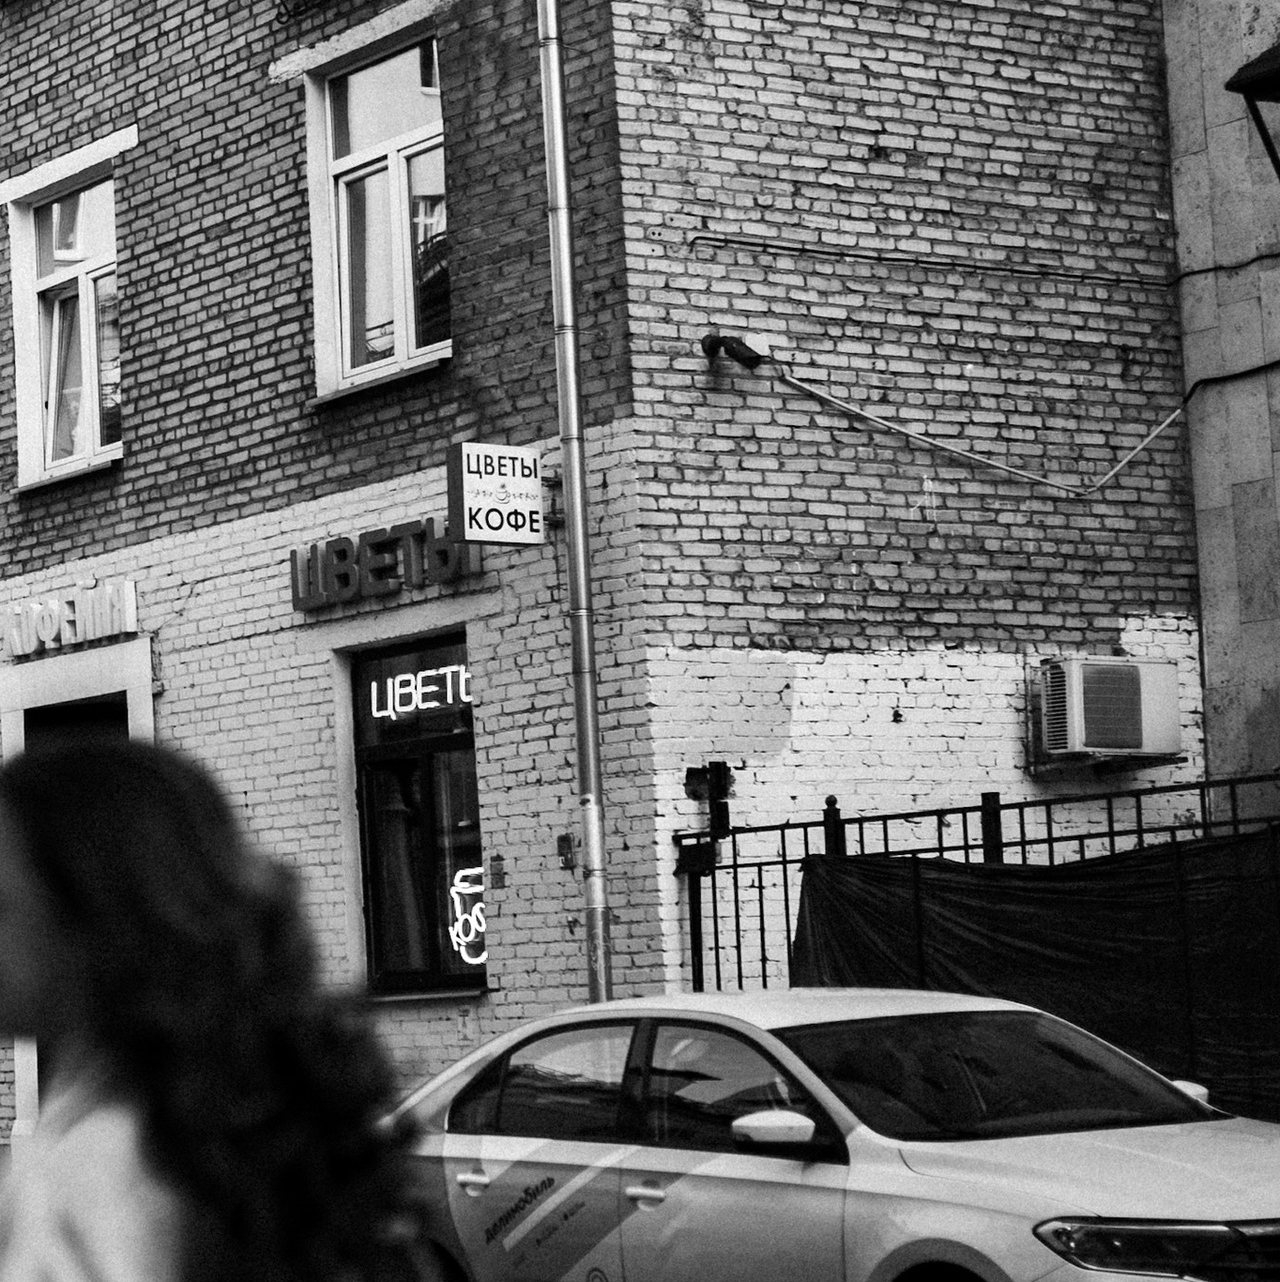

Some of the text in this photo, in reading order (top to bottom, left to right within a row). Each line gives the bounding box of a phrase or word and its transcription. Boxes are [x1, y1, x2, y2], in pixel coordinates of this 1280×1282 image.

[466, 453, 539, 479] ЦВЕТЫ
[468, 507, 541, 533] КОФЕ
[4, 579, 137, 656] КОФЕЙНЯ
[485, 1176, 555, 1245] делимобиль
